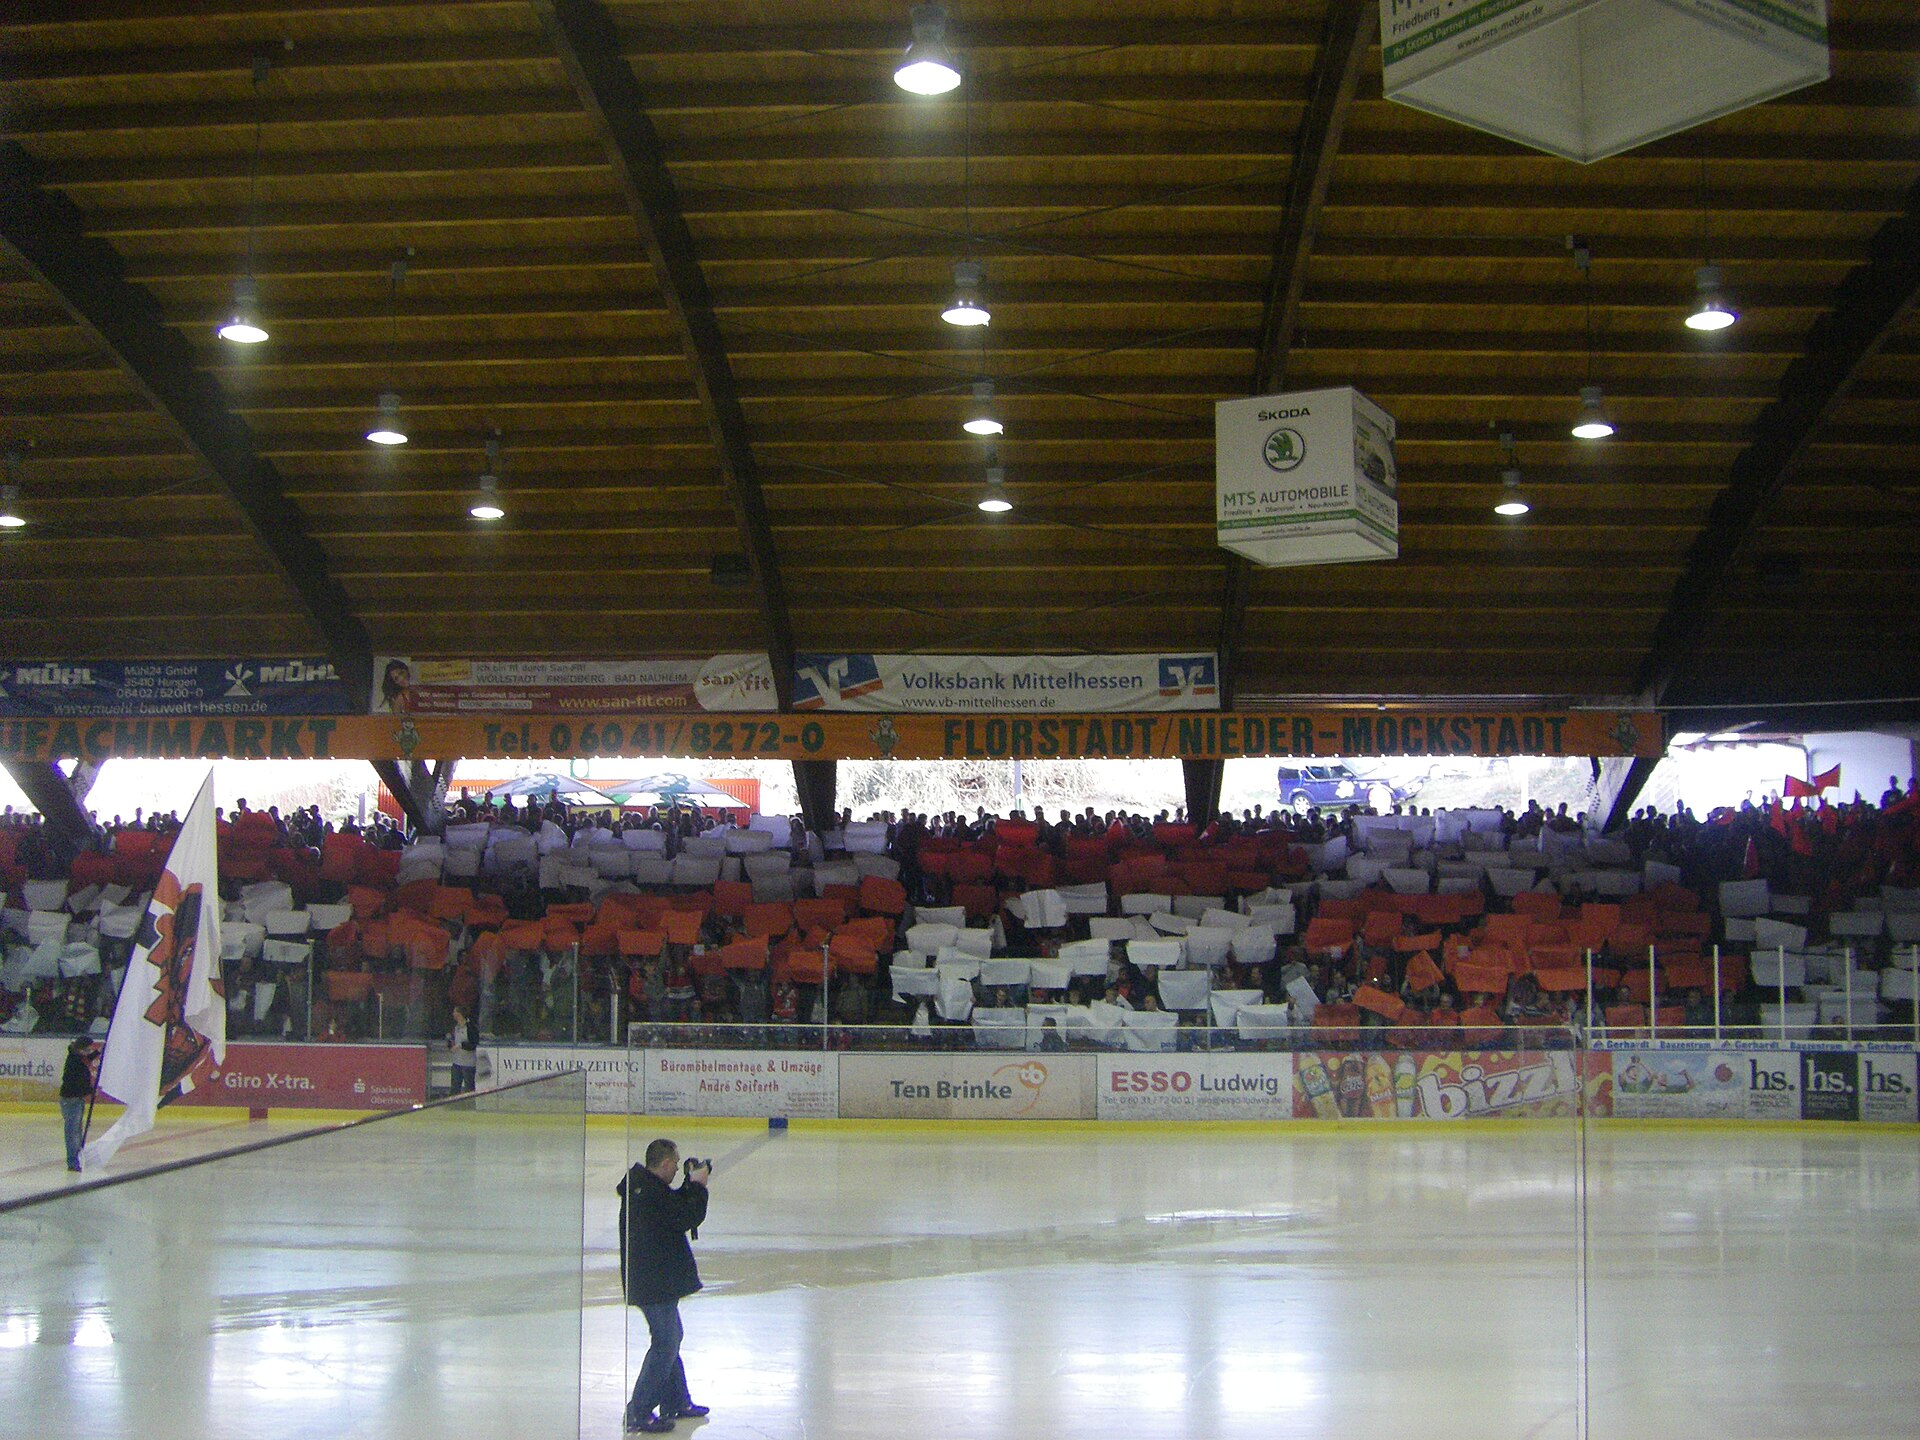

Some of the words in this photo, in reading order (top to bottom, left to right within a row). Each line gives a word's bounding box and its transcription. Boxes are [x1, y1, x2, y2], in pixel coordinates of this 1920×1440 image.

[1392, 6, 1440, 35] Friedberg
[1223, 491, 1257, 507] MTS
[1260, 484, 1349, 504] AUTOMOBILE
[16, 662, 96, 685] MÜHL
[165, 665, 198, 676] GmbH
[260, 661, 341, 683] MÜHL
[547, 673, 605, 683] FRIEDBERG
[615, 673, 636, 683] BAD
[640, 673, 687, 683] NAUHEIM
[744, 672, 771, 691] fit
[902, 672, 1006, 690] Volksbank
[1013, 672, 1144, 690] Mittelhessen
[54, 700, 268, 714] www.muehl-bauwelt-hessen.de
[559, 695, 687, 710] www.san-fit.com
[901, 696, 1056, 709] www.vb-mittelhessen.de
[483, 722, 539, 753] Tel.
[1607, 1040, 1650, 1050] Gerhardt
[1660, 1040, 1711, 1050] Bauzentrum
[1735, 1040, 1779, 1050] Gerhardt
[1790, 1041, 1844, 1051] Bauzentrum
[1867, 1042, 1913, 1051] Gerhardt
[588, 1060, 640, 1073] ZEITUNG
[661, 1058, 762, 1076] Büromöbelmontage
[767, 1058, 776, 1072] &
[781, 1059, 823, 1076] Umzüge
[1749, 1058, 1795, 1091] hs.
[1806, 1058, 1854, 1093] hs.
[225, 1072, 261, 1089] Giro
[266, 1072, 315, 1090] X-tra.
[1111, 1071, 1192, 1093] ESSO
[1200, 1073, 1278, 1095] Ludwig
[1417, 1050, 1576, 1119] bizzl
[1864, 1060, 1912, 1093] hs.
[370, 1085, 412, 1096] Sparkasse
[891, 1080, 931, 1099] Ten
[937, 1079, 1013, 1099] Brinke
